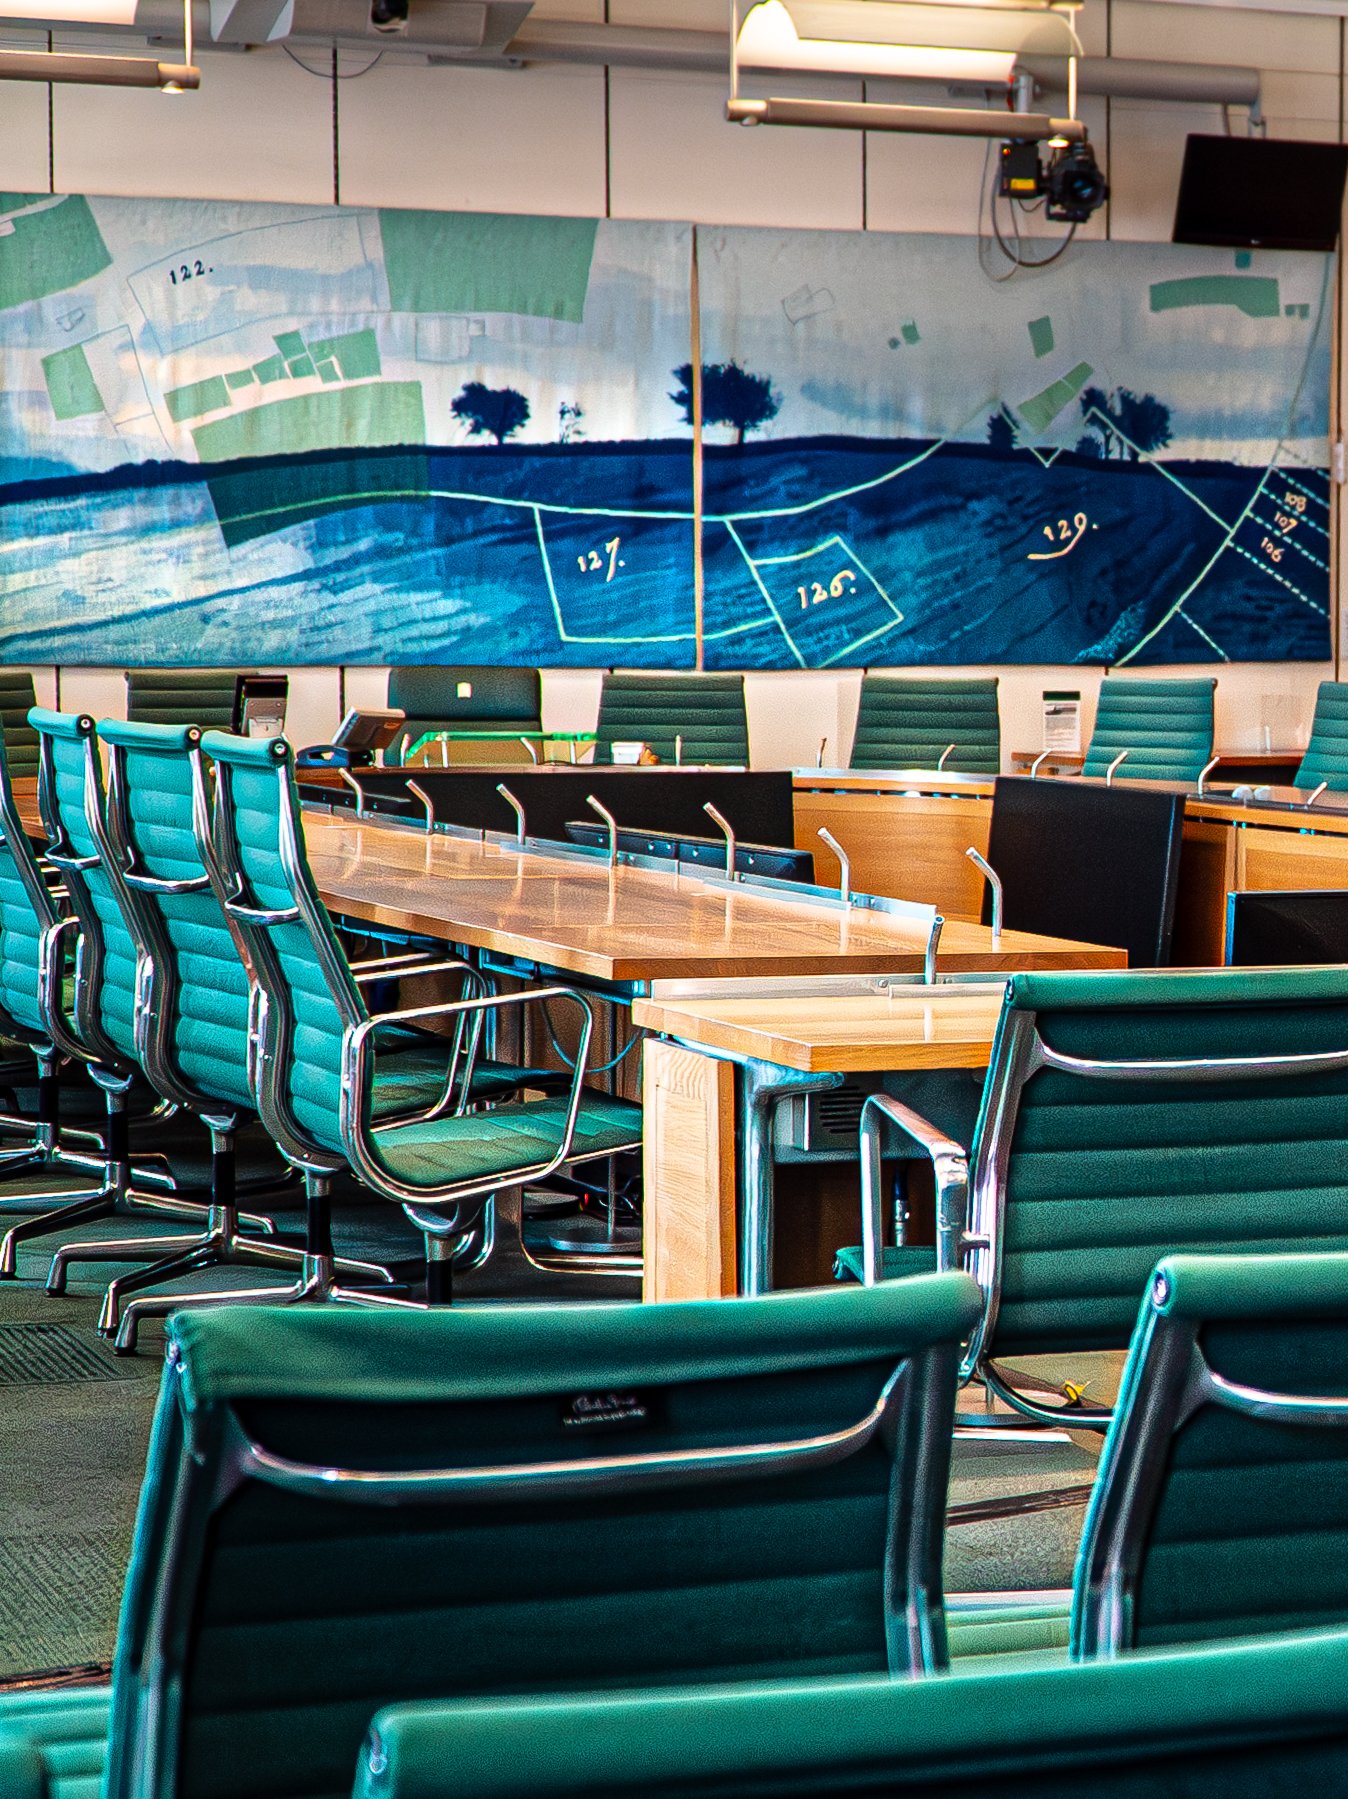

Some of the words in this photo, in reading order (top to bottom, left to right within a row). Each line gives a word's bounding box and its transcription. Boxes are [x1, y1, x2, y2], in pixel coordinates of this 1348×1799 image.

[169, 260, 213, 285] 122.
[1285, 492, 1307, 513] 108
[1274, 511, 1298, 534] 107
[1261, 537, 1285, 563] 106
[797, 569, 856, 609] 126.
